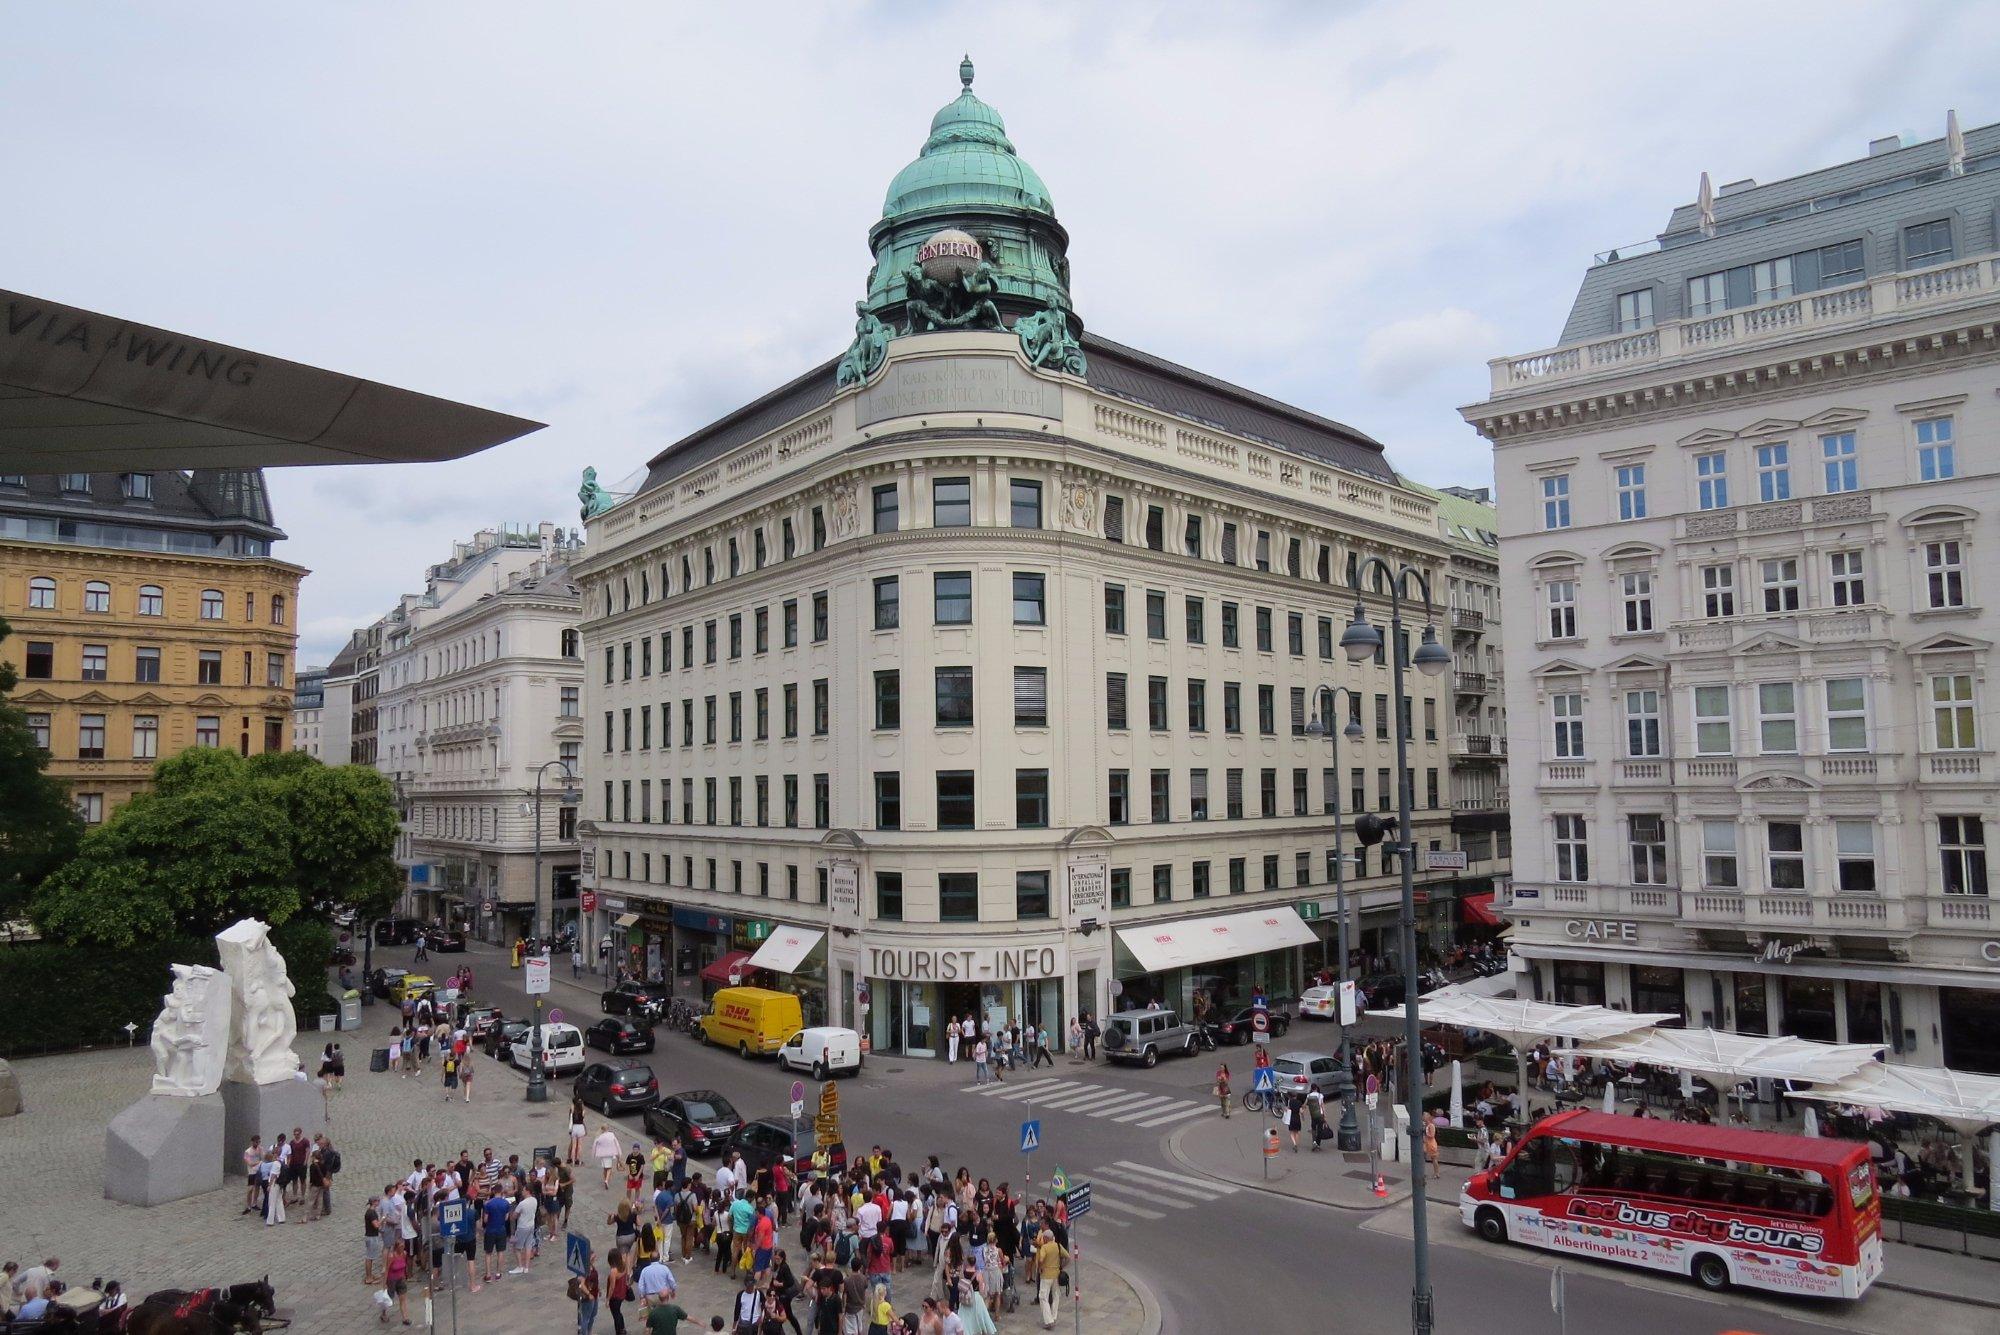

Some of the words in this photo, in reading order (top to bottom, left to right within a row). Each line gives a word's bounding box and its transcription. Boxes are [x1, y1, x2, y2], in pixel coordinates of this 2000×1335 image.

[127, 333, 258, 385] WING
[1565, 920, 1638, 941] CAFE
[446, 1209, 460, 1218] Taxi
[1770, 1220, 1784, 1228] let's
[1785, 1222, 1798, 1230] talk
[1800, 1224, 1824, 1234] history
[1554, 1235, 1638, 1259] Albertinaplatz
[1641, 1250, 1648, 1260] 2
[1739, 1265, 1837, 1287] www.redbuscitytours.at
